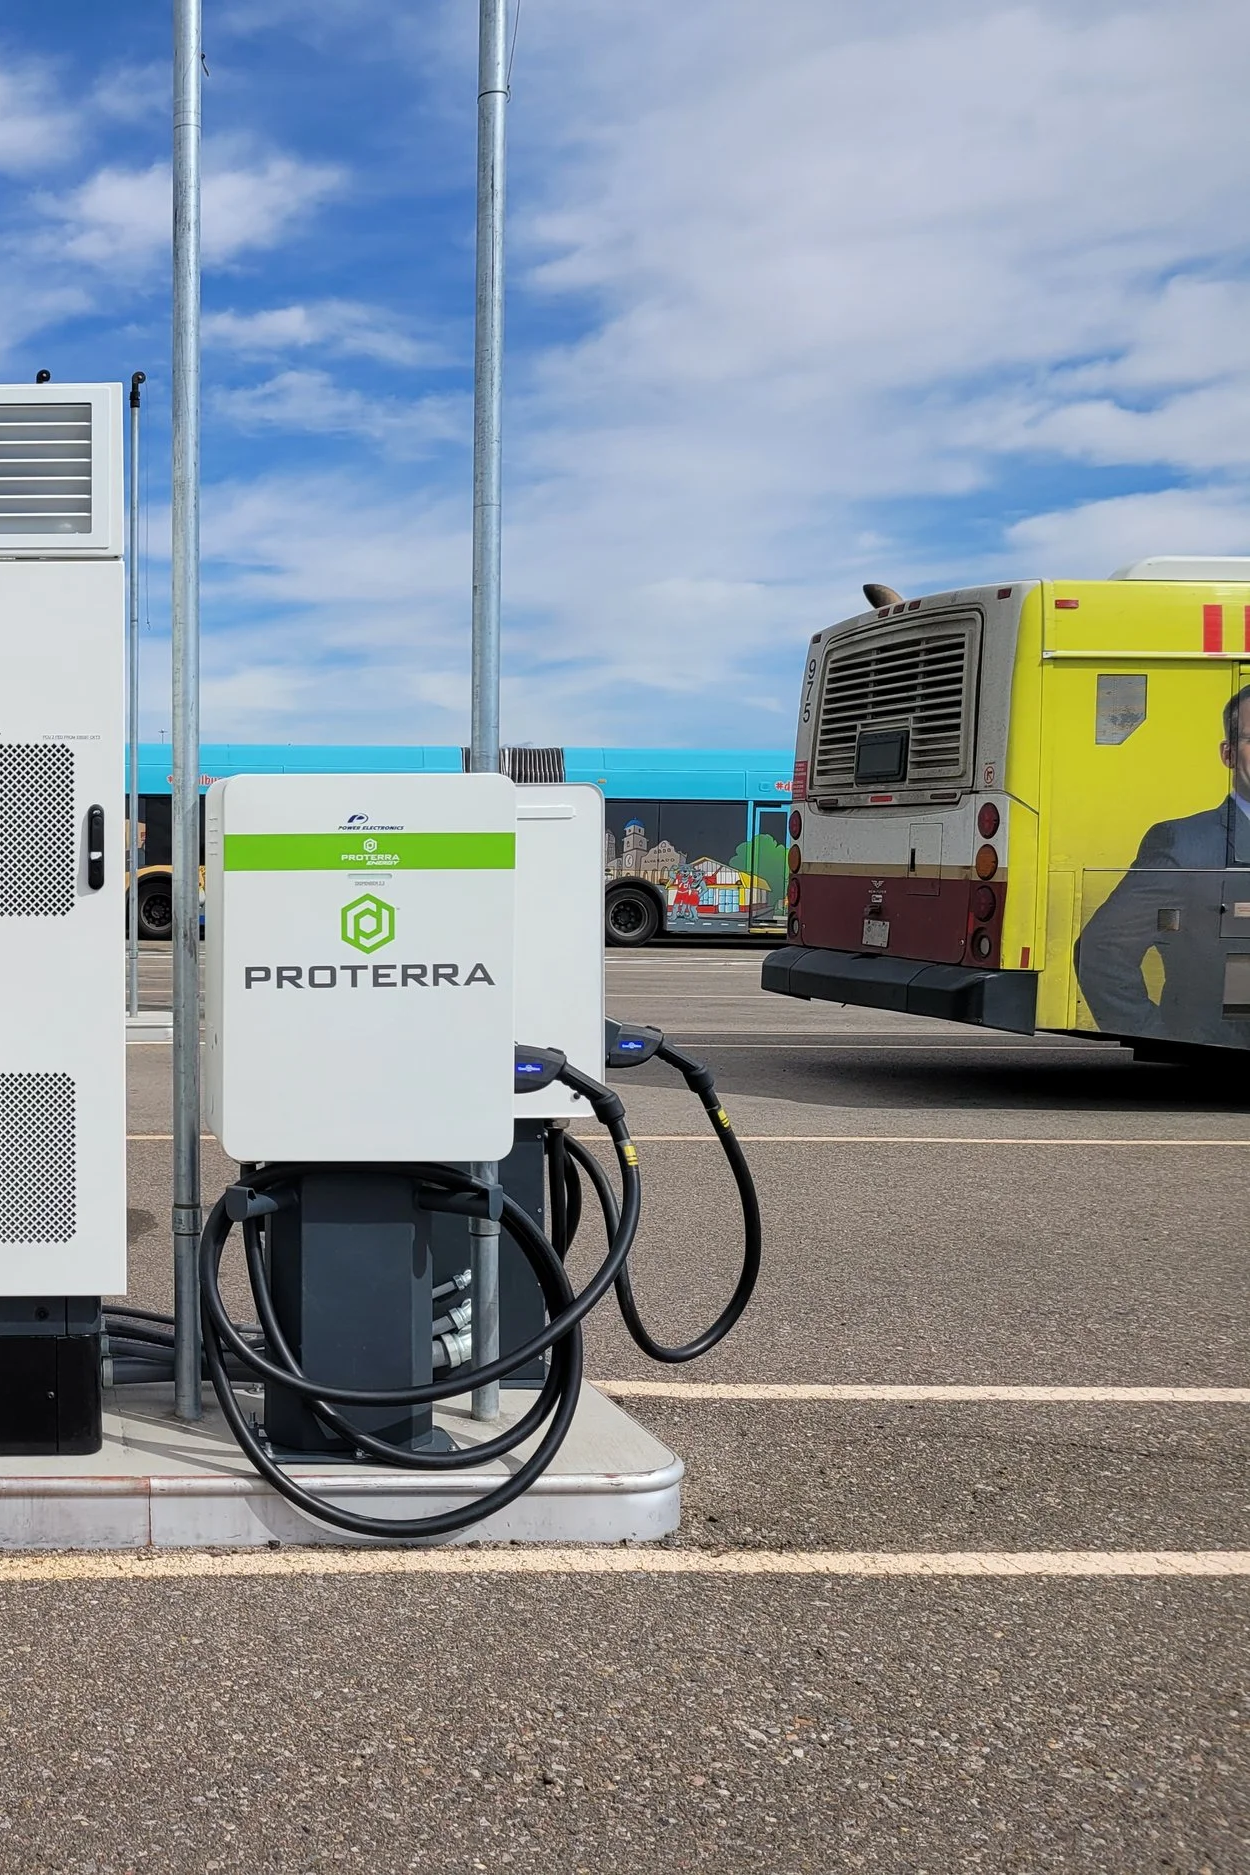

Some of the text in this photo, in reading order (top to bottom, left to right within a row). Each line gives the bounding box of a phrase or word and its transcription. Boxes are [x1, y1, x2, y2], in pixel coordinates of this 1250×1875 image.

[803, 658, 817, 723] 975
[341, 853, 400, 861] PROTERRA
[244, 962, 497, 990] PROTERRA
